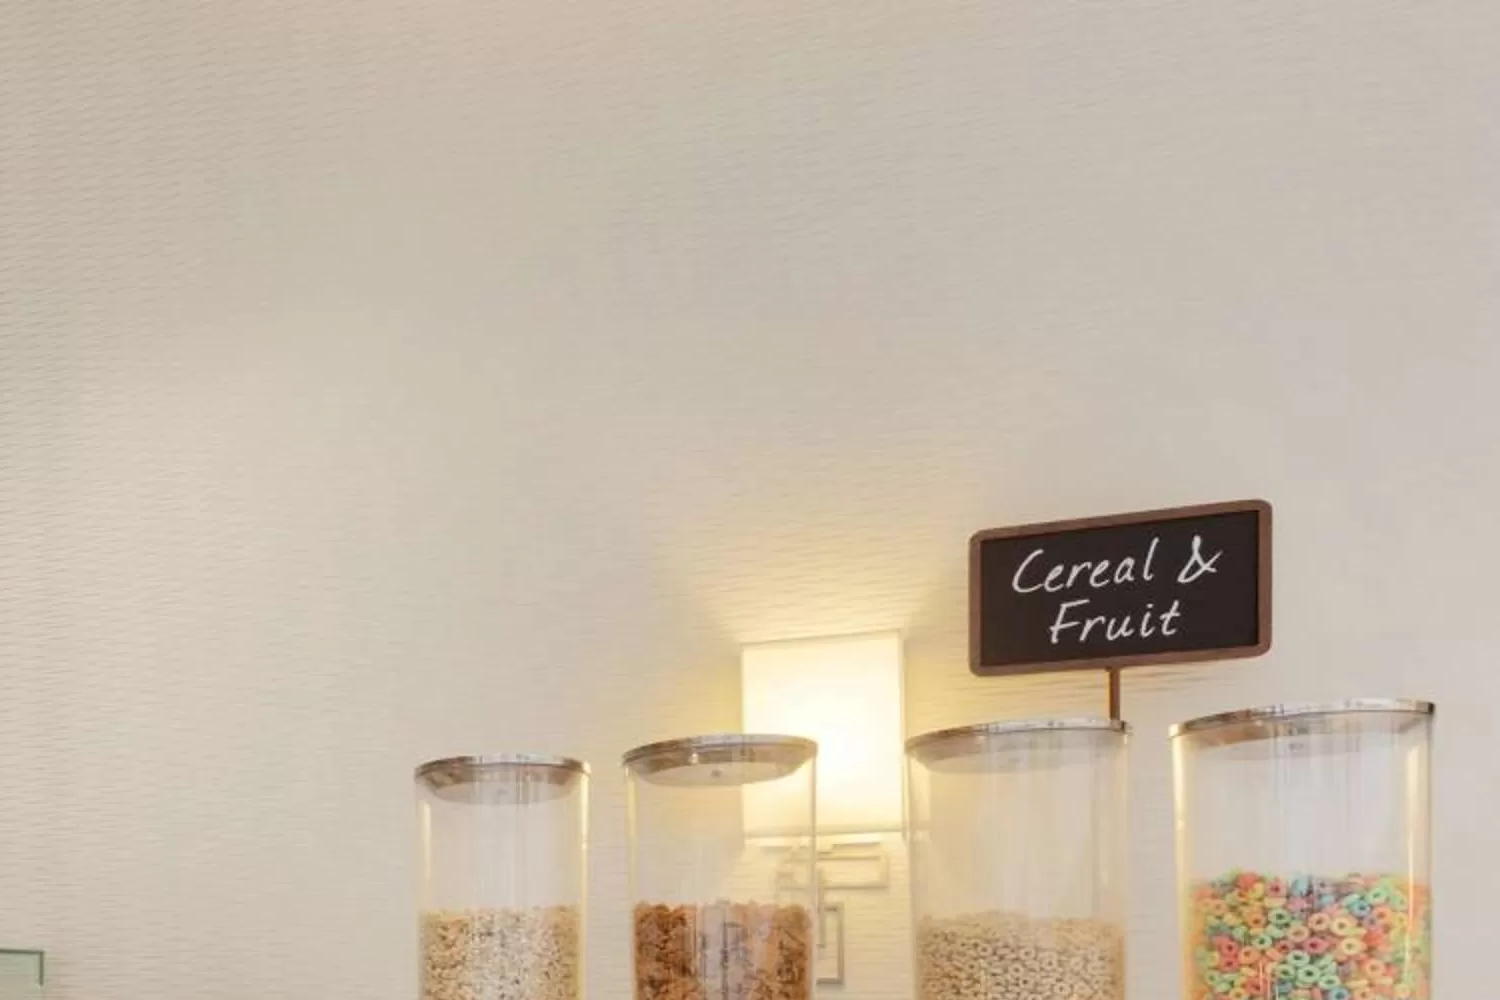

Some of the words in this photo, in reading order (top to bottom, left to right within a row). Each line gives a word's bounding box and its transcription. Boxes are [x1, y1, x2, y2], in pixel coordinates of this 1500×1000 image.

[1011, 536, 1160, 593] Cereal
[1177, 534, 1223, 583] &
[1049, 599, 1181, 644] Fruit
